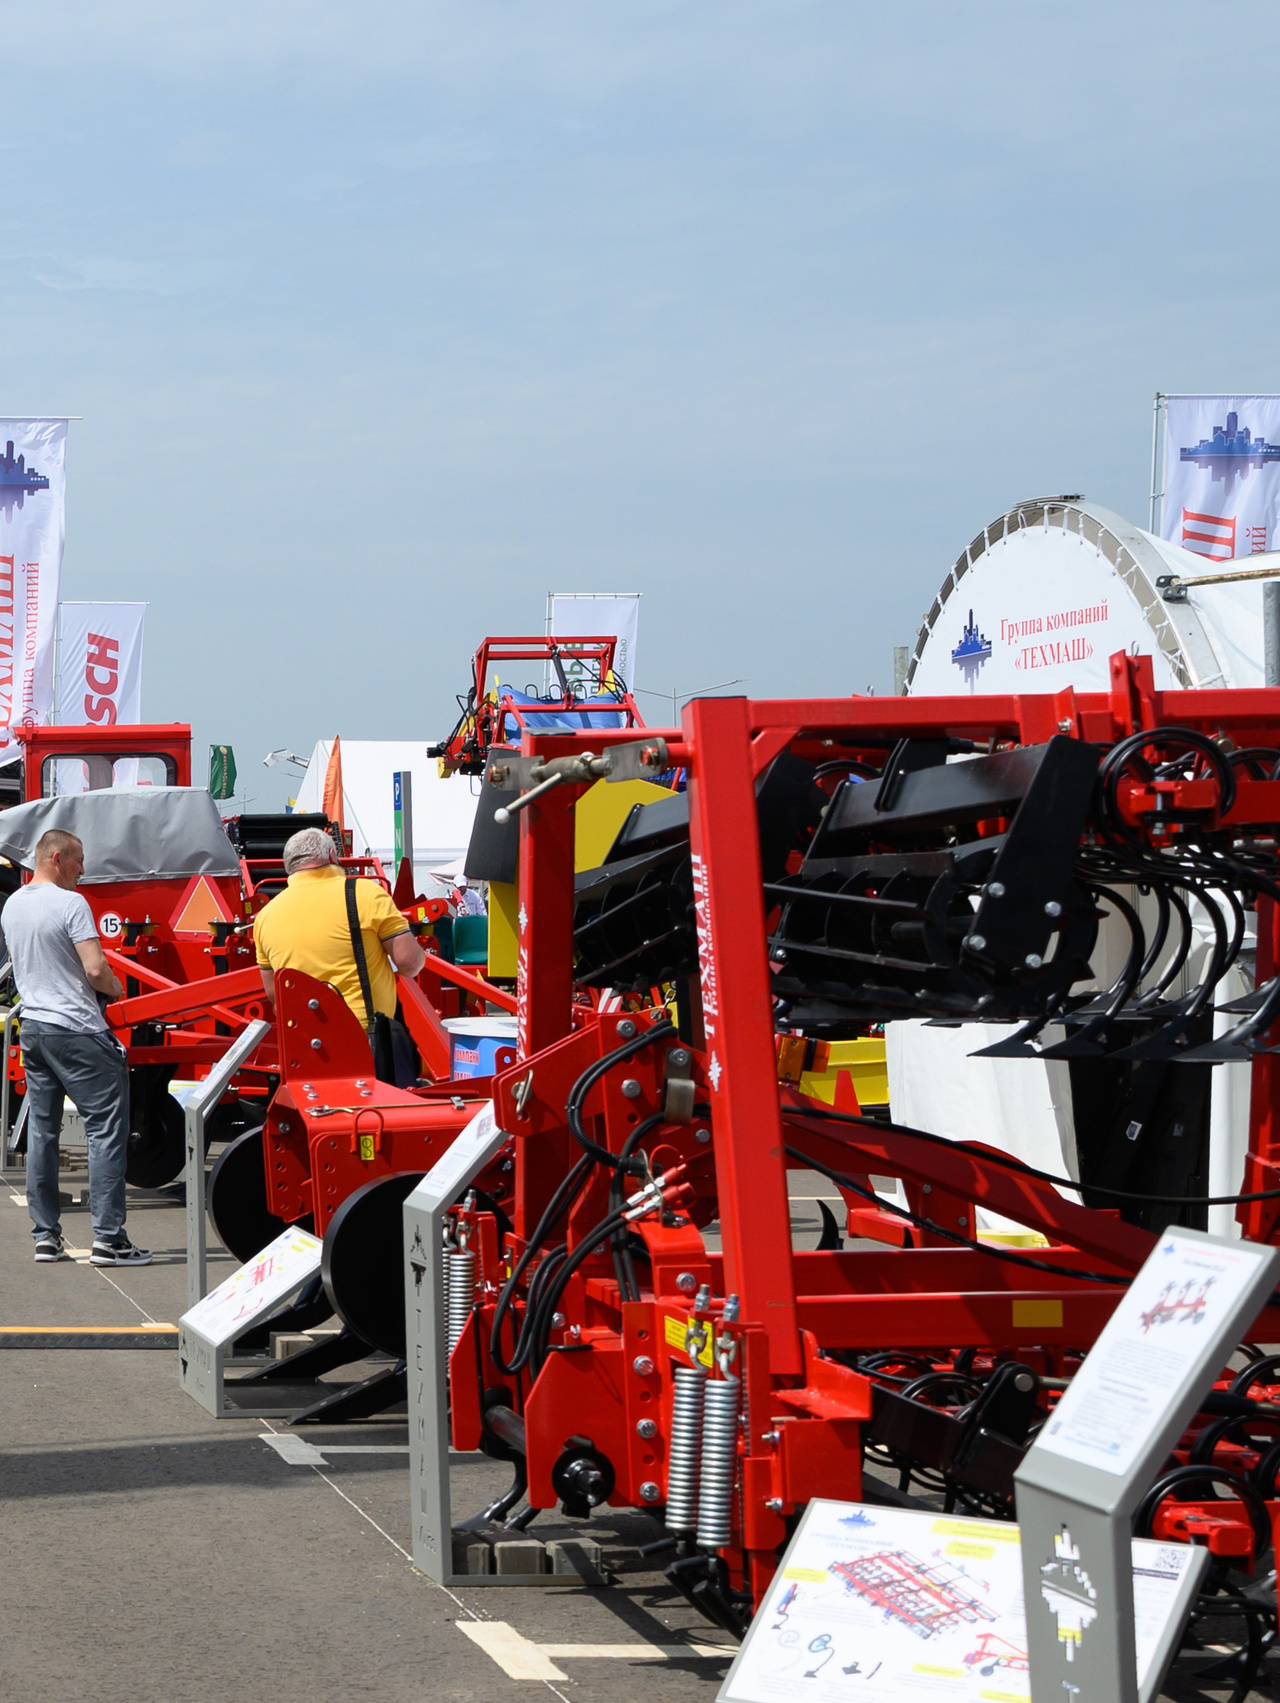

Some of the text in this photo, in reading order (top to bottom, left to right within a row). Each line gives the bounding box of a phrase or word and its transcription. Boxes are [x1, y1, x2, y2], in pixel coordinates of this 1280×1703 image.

[22, 562, 39, 661] компаний
[1000, 599, 1108, 645] Группа компаний
[84, 632, 120, 725] SCH
[1014, 638, 1094, 670] «ТЕХМАШ»
[103, 918, 118, 933] 15
[691, 853, 716, 1040] ТЕХМАШ
